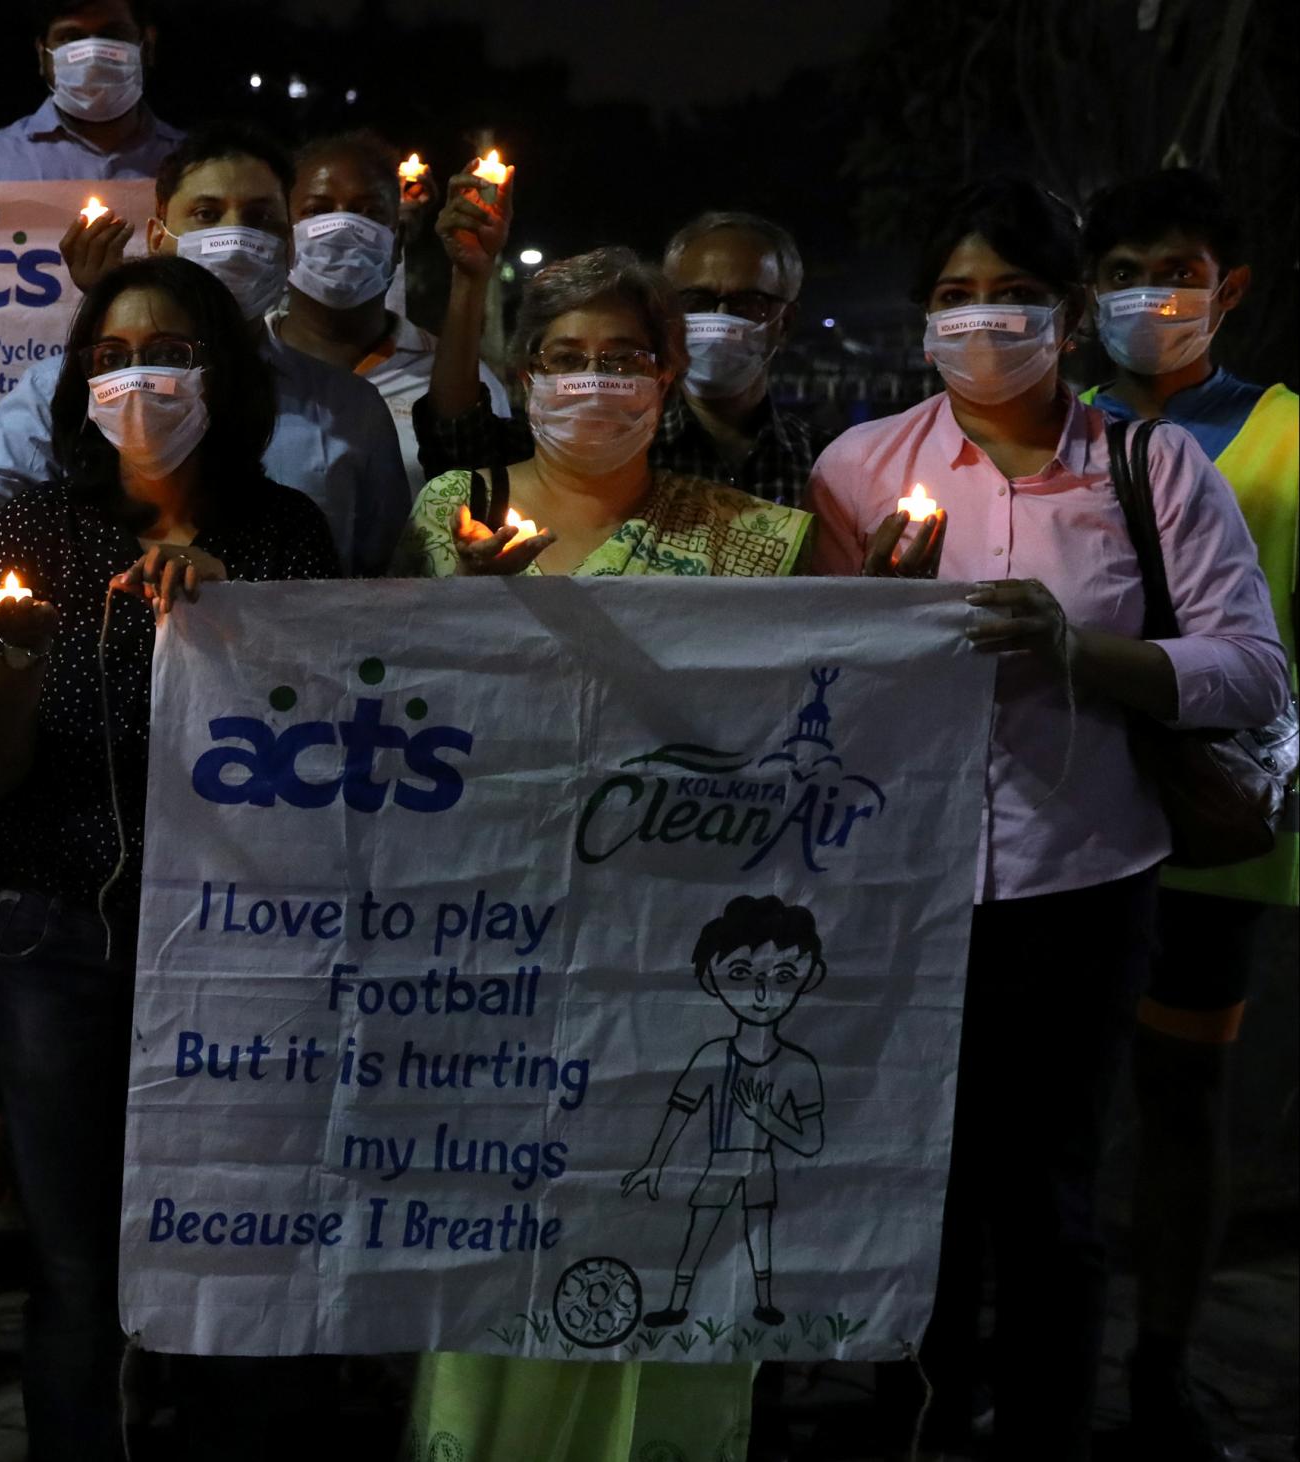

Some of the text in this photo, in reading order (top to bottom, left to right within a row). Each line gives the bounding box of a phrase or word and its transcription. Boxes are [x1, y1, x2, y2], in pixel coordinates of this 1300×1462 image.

[210, 240, 238, 249] KOLKATA
[240, 240, 256, 249] CLEAN
[941, 319, 1007, 332] KOLKATA CLEAN AIR
[1137, 301, 1158, 309] CLEAN
[97, 380, 156, 400] KOLKATA CLEAN AIR
[563, 380, 634, 391] KOLKATA CLEAN AIR
[191, 696, 475, 814] acts
[675, 776, 787, 804] KOLKATA
[576, 774, 873, 873] Clean Air
[199, 881, 556, 956] I Love to play
[328, 963, 542, 1017] Football
[175, 1031, 591, 1110] But it is hurting
[343, 1123, 568, 1190] my lungs
[149, 1197, 562, 1254] Because I Breathe
